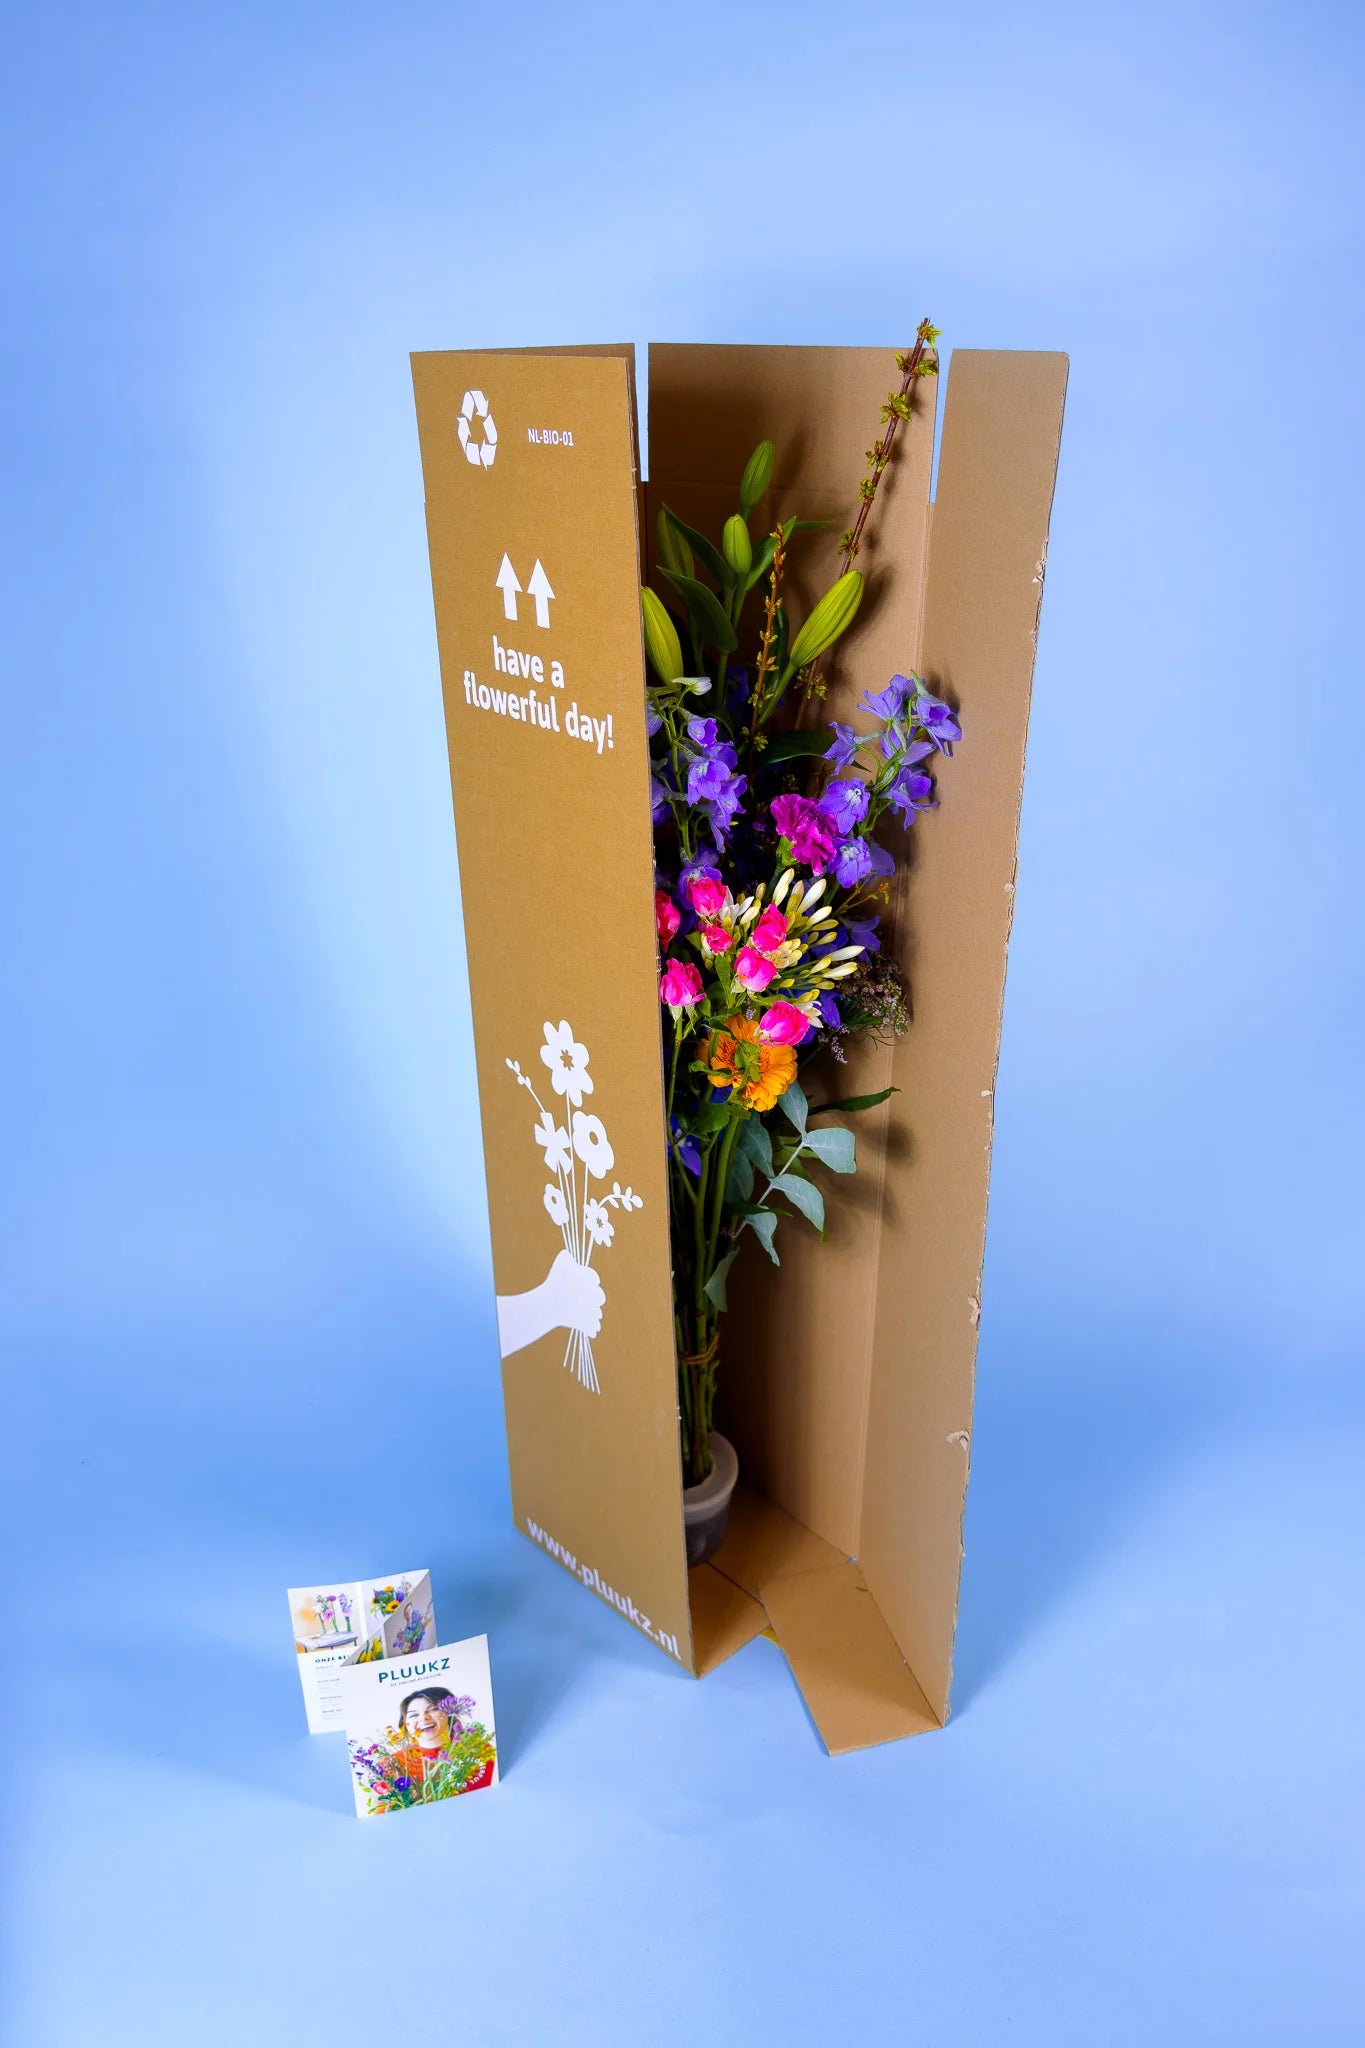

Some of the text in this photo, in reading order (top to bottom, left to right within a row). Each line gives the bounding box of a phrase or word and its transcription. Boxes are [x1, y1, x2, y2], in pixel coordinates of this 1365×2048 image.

[527, 428, 574, 447] NL-BIO-01
[492, 634, 565, 689] have a
[463, 670, 614, 755] flowerful day!
[526, 1517, 682, 1661] www.pluukz.nl
[378, 1657, 451, 1684] PLUUKZ
